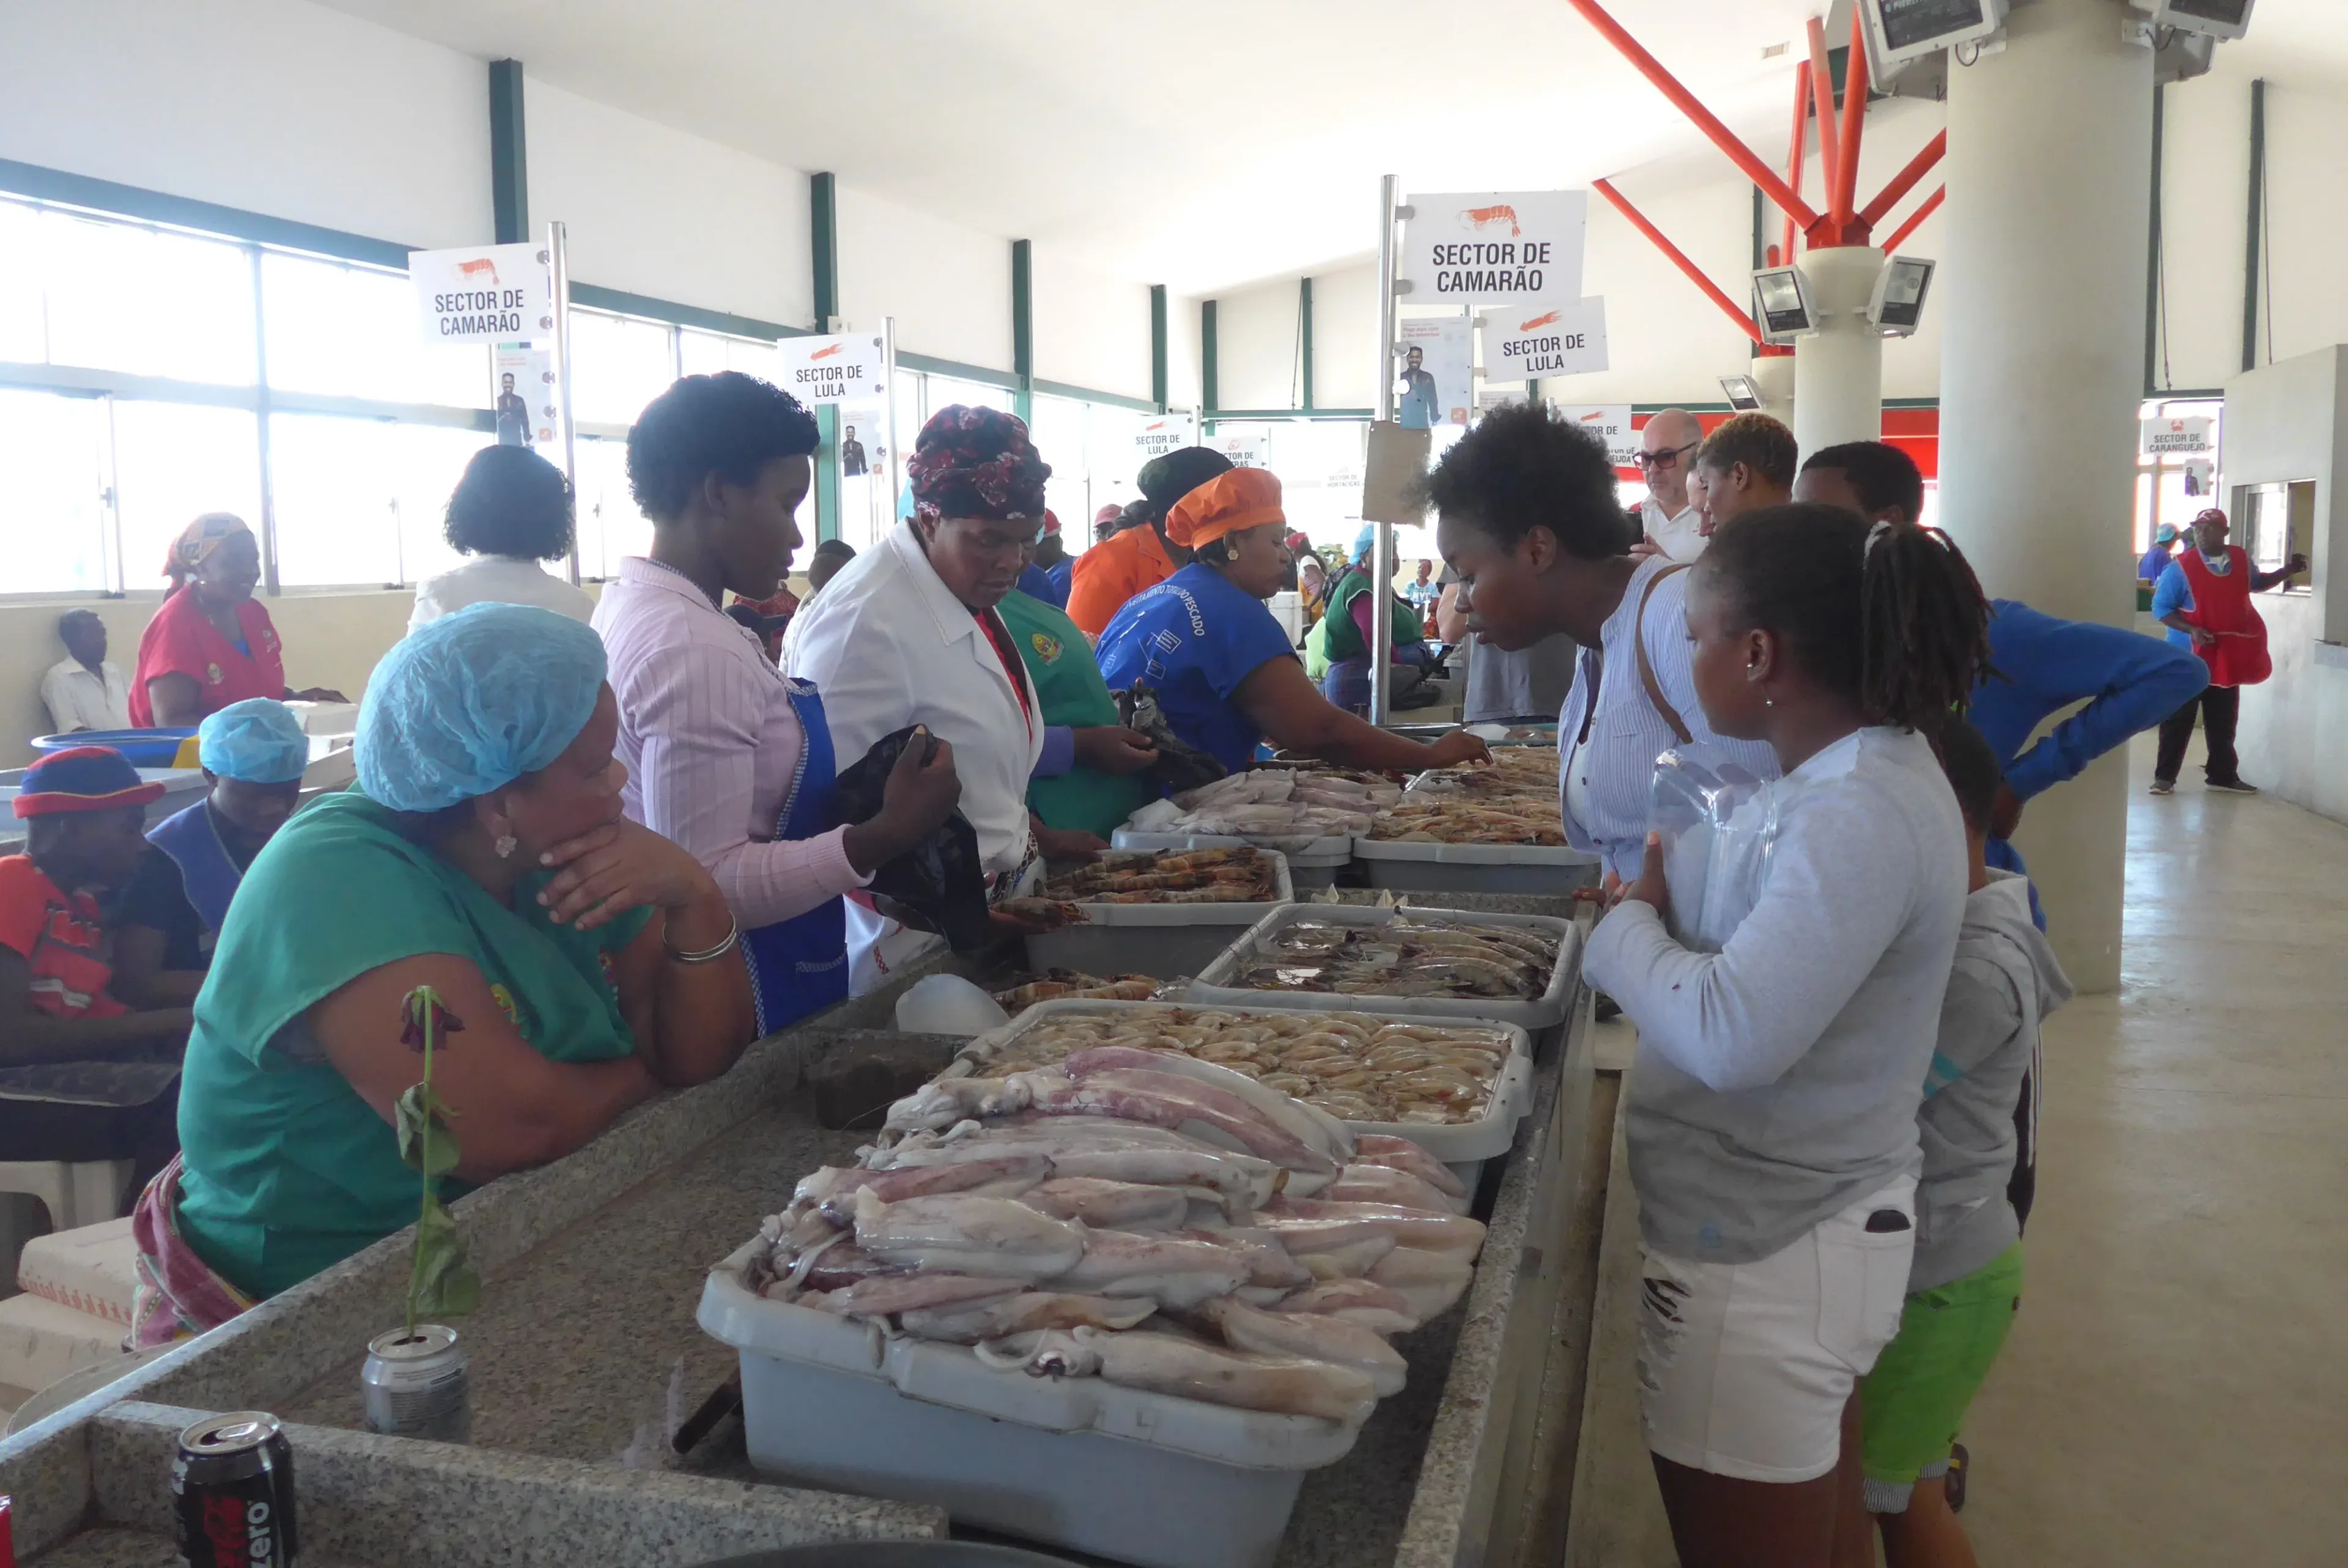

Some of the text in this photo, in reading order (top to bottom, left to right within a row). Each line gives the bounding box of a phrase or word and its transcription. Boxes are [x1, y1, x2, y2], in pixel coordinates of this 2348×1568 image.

[1433, 242, 1551, 266] SECTOR DE
[1436, 265, 1543, 293] CAMARÃO
[435, 289, 524, 313] SECTOR DE
[440, 309, 520, 336] CAMARÃO
[1503, 333, 1586, 356] SECTOR DE
[1526, 354, 1565, 372] LULA
[796, 365, 863, 383] SECTOR DE
[814, 383, 846, 397] LULA
[1606, 425, 1618, 435] DE
[2154, 433, 2201, 443] SECTOR DE
[1135, 434, 1181, 445] SECTOR DE
[2149, 443, 2206, 452] CARANGUEJO
[1148, 445, 1169, 454] LULA
[1183, 596, 1205, 636] PESCADO
